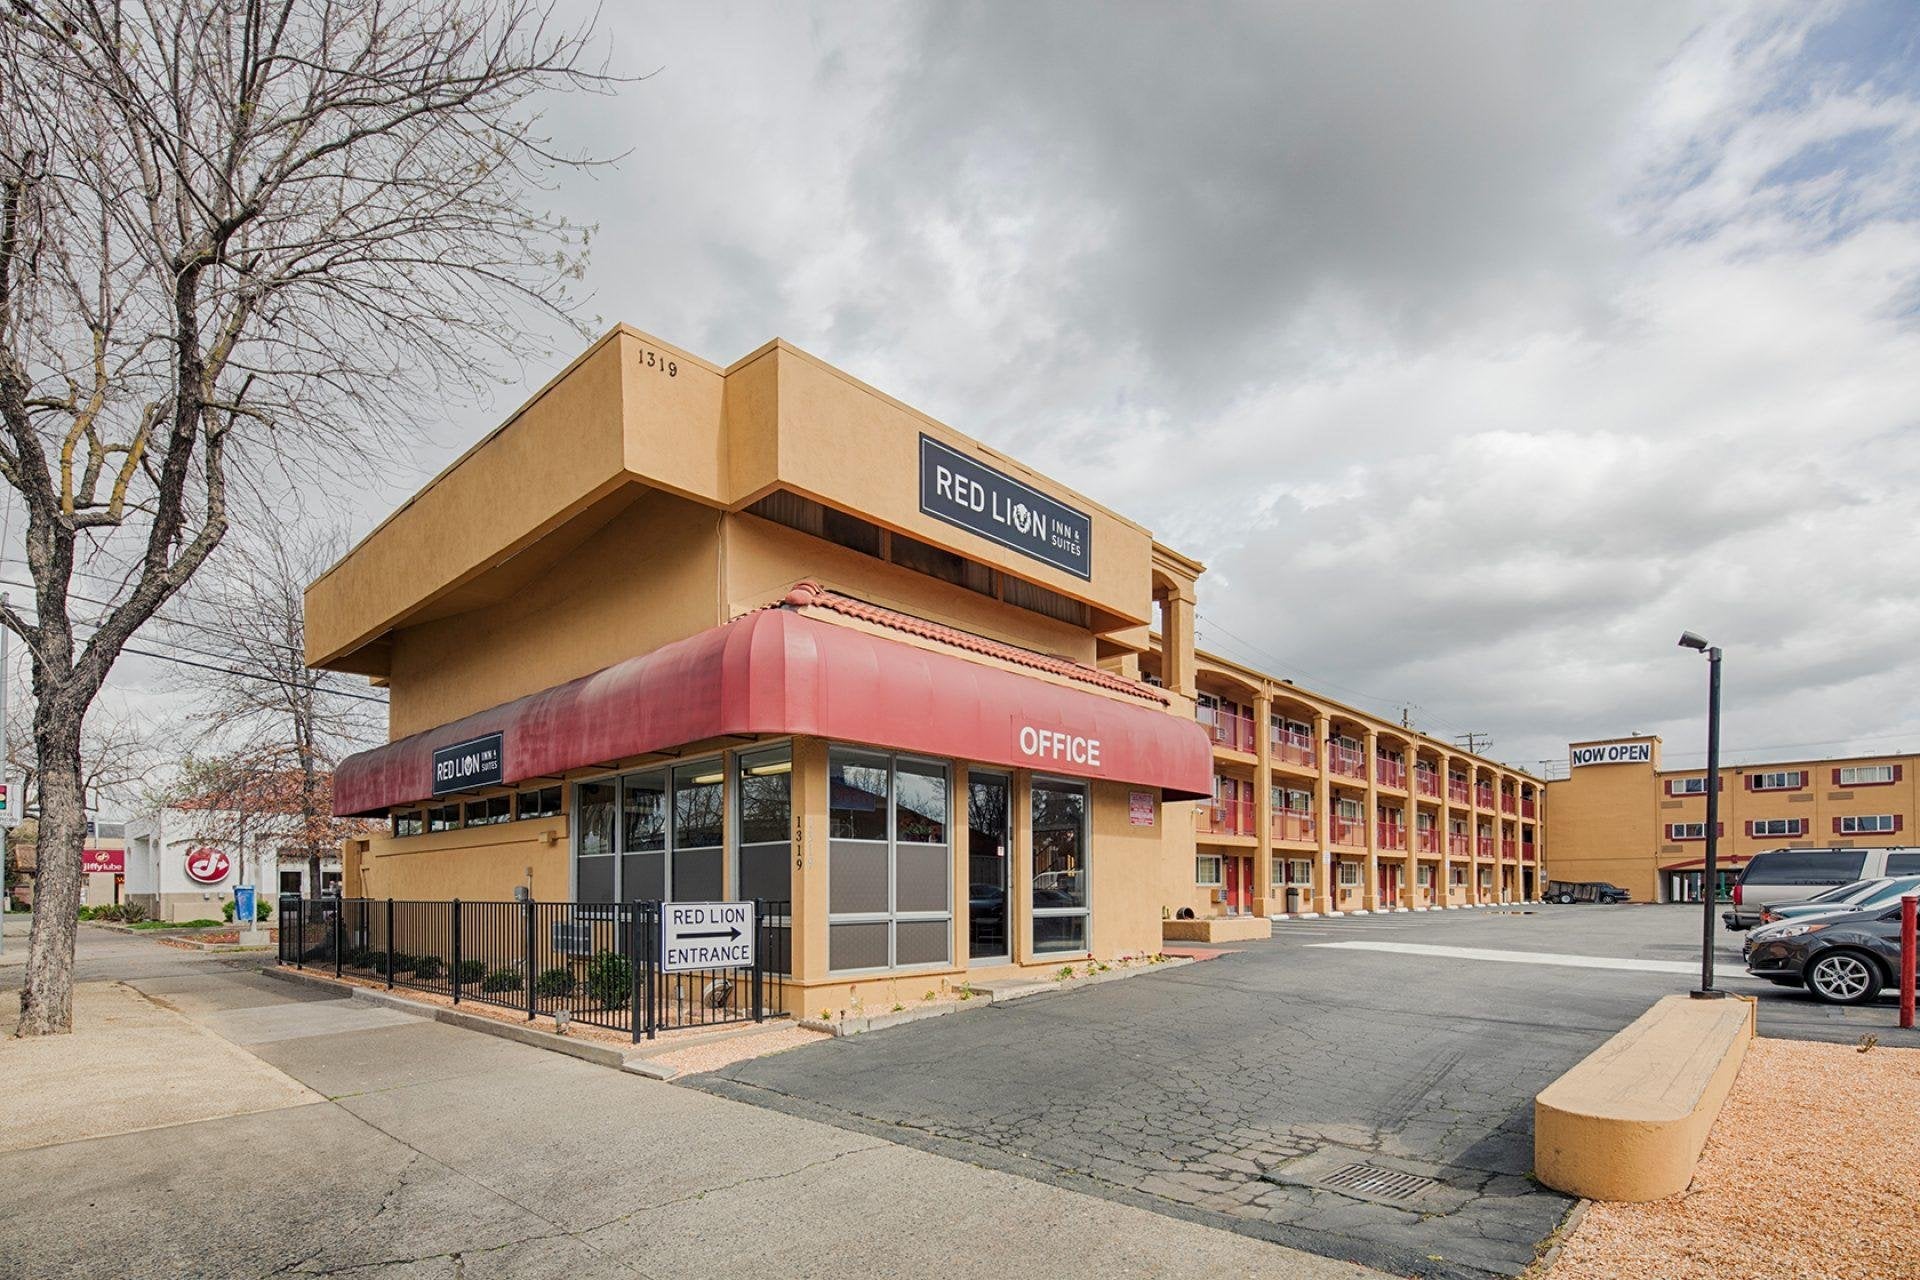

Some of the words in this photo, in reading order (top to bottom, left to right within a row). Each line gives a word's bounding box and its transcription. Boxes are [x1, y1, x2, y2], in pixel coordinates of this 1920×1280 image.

[638, 349, 677, 377] 1319
[936, 464, 985, 513] RED
[992, 491, 1047, 541] LION
[1052, 518, 1072, 540] INN
[1073, 530, 1081, 541] &
[1052, 534, 1081, 557] SUITES
[1020, 726, 1101, 767] OFFICE
[1573, 747, 1606, 765] NOW
[1608, 744, 1650, 761] OPEN
[437, 762, 455, 782] RED
[455, 753, 480, 777] LION
[795, 816, 803, 871] 1319
[673, 909, 705, 925] RED
[710, 908, 745, 924] LION
[668, 945, 750, 965] ENTRANCE
